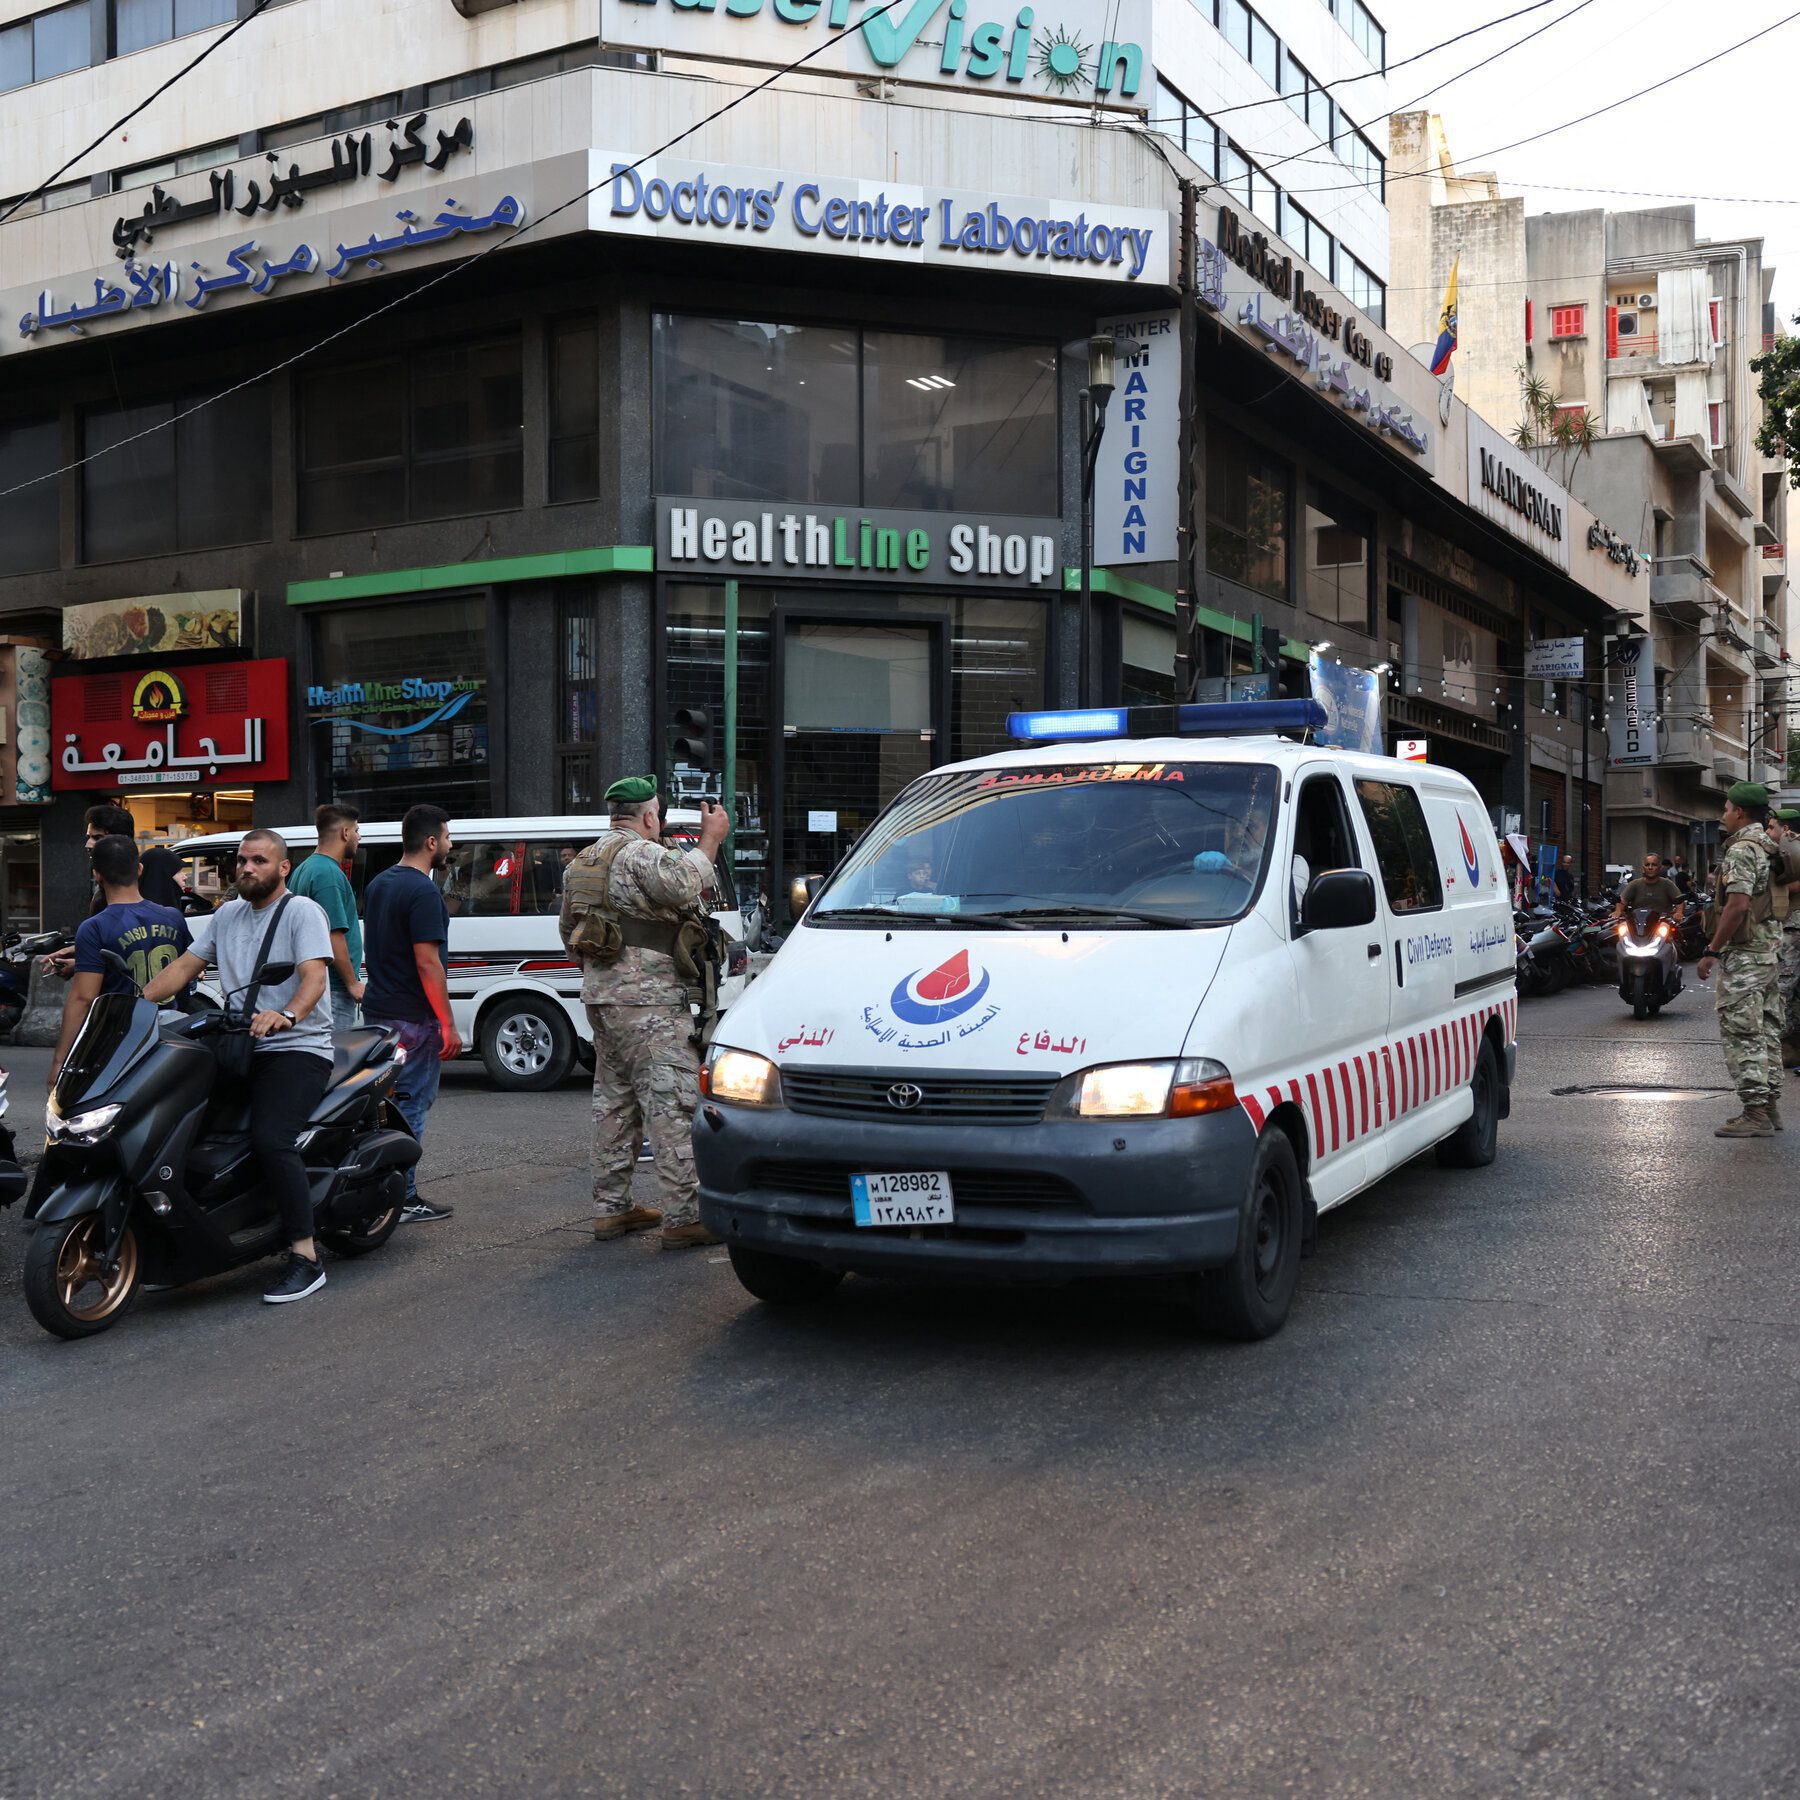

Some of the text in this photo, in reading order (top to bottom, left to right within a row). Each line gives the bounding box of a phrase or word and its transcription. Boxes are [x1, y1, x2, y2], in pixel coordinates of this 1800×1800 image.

[234, 132, 372, 217] الليزر
[377, 112, 474, 183] مركز
[610, 163, 1153, 280] Doctors' Center Laboratory
[18, 192, 526, 340] مختبر مركز الأطباء
[1122, 344, 1150, 555] MARIGNAN
[670, 507, 1055, 584] HealthLine Shop
[62, 718, 262, 775] الجامعة
[495, 858, 509, 876] 4
[118, 924, 179, 949] ANSU FATI
[1407, 932, 1453, 964] Civil Defence
[777, 1024, 1087, 1056] الدفاع المدني
